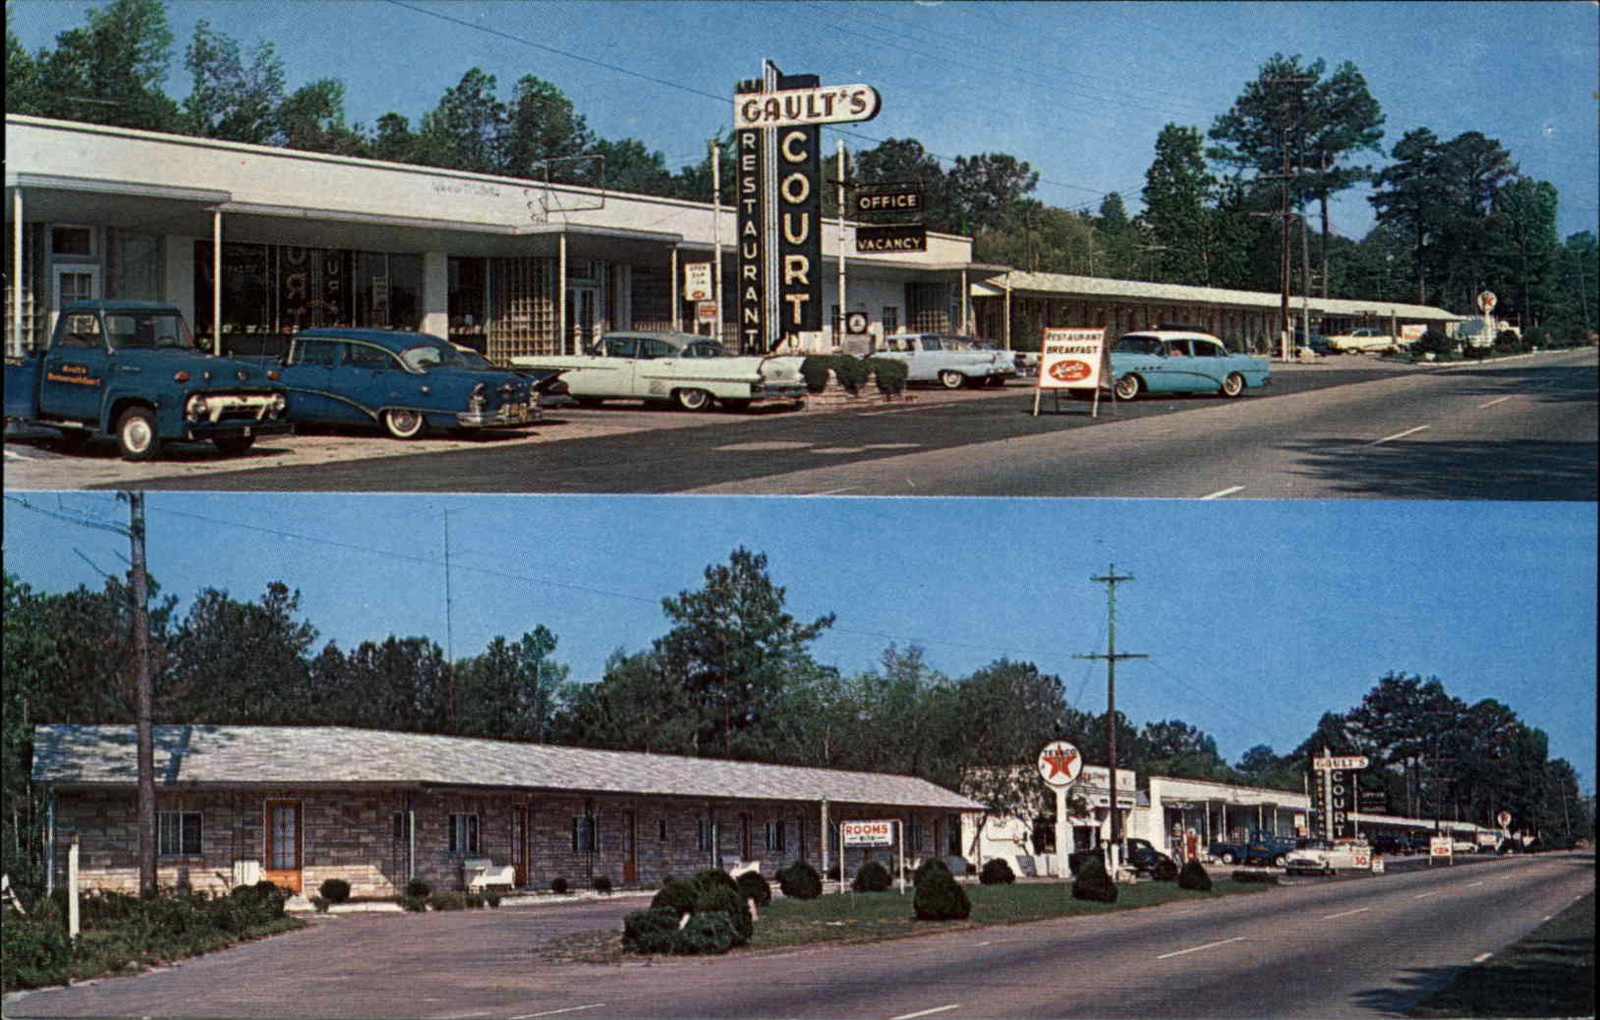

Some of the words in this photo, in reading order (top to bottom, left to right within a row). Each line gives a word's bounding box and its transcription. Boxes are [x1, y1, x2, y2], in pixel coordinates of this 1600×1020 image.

[741, 91, 867, 122] GAULT'S
[859, 194, 917, 209] OFFICE
[781, 131, 810, 325] COURT
[742, 133, 759, 348] RESTAURANT
[858, 237, 921, 249] VACANCY
[1046, 333, 1102, 341] RESTAURANT
[1046, 345, 1098, 354] BREAKFAST
[1332, 771, 1345, 837] COURT
[845, 824, 889, 834] ROOMS
